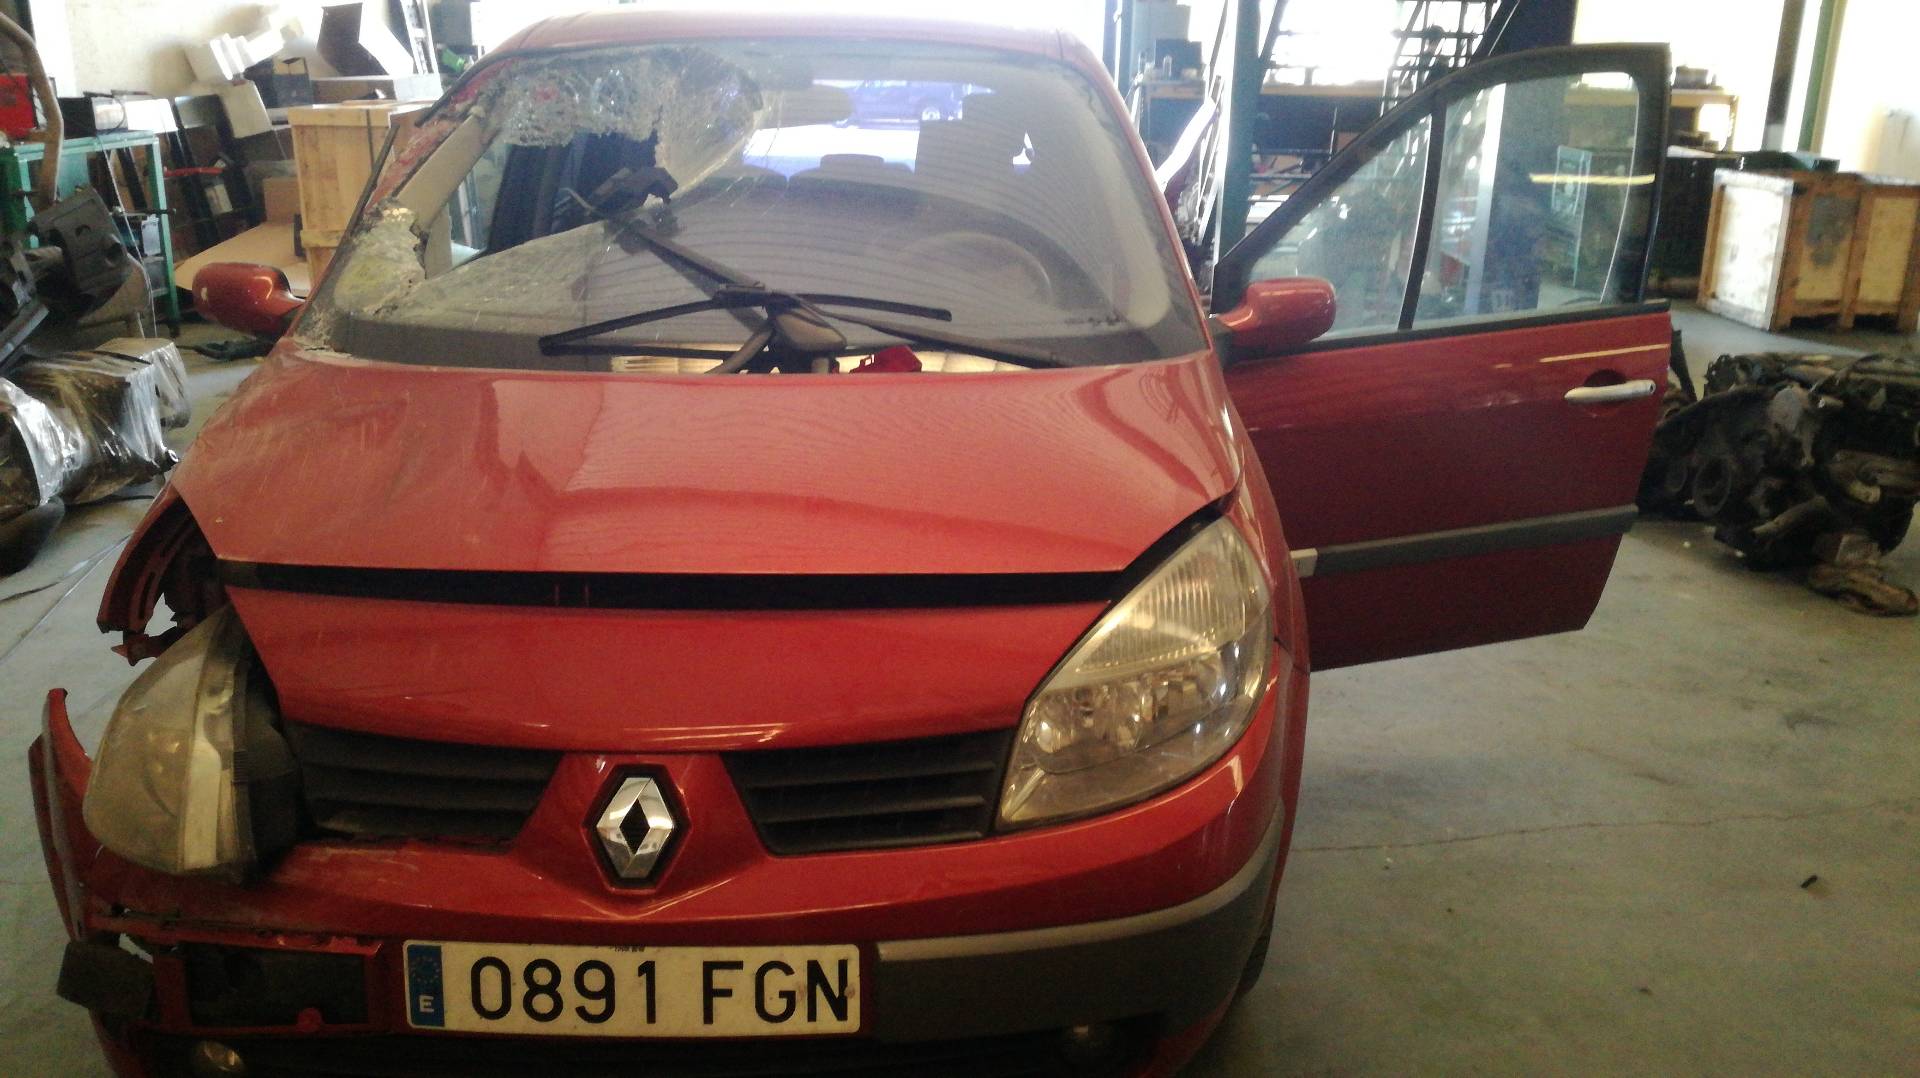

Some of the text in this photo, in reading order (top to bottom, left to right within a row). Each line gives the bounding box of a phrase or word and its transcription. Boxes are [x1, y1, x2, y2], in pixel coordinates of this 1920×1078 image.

[419, 995, 435, 1013] E
[470, 956, 849, 1025] 0891 FGN
